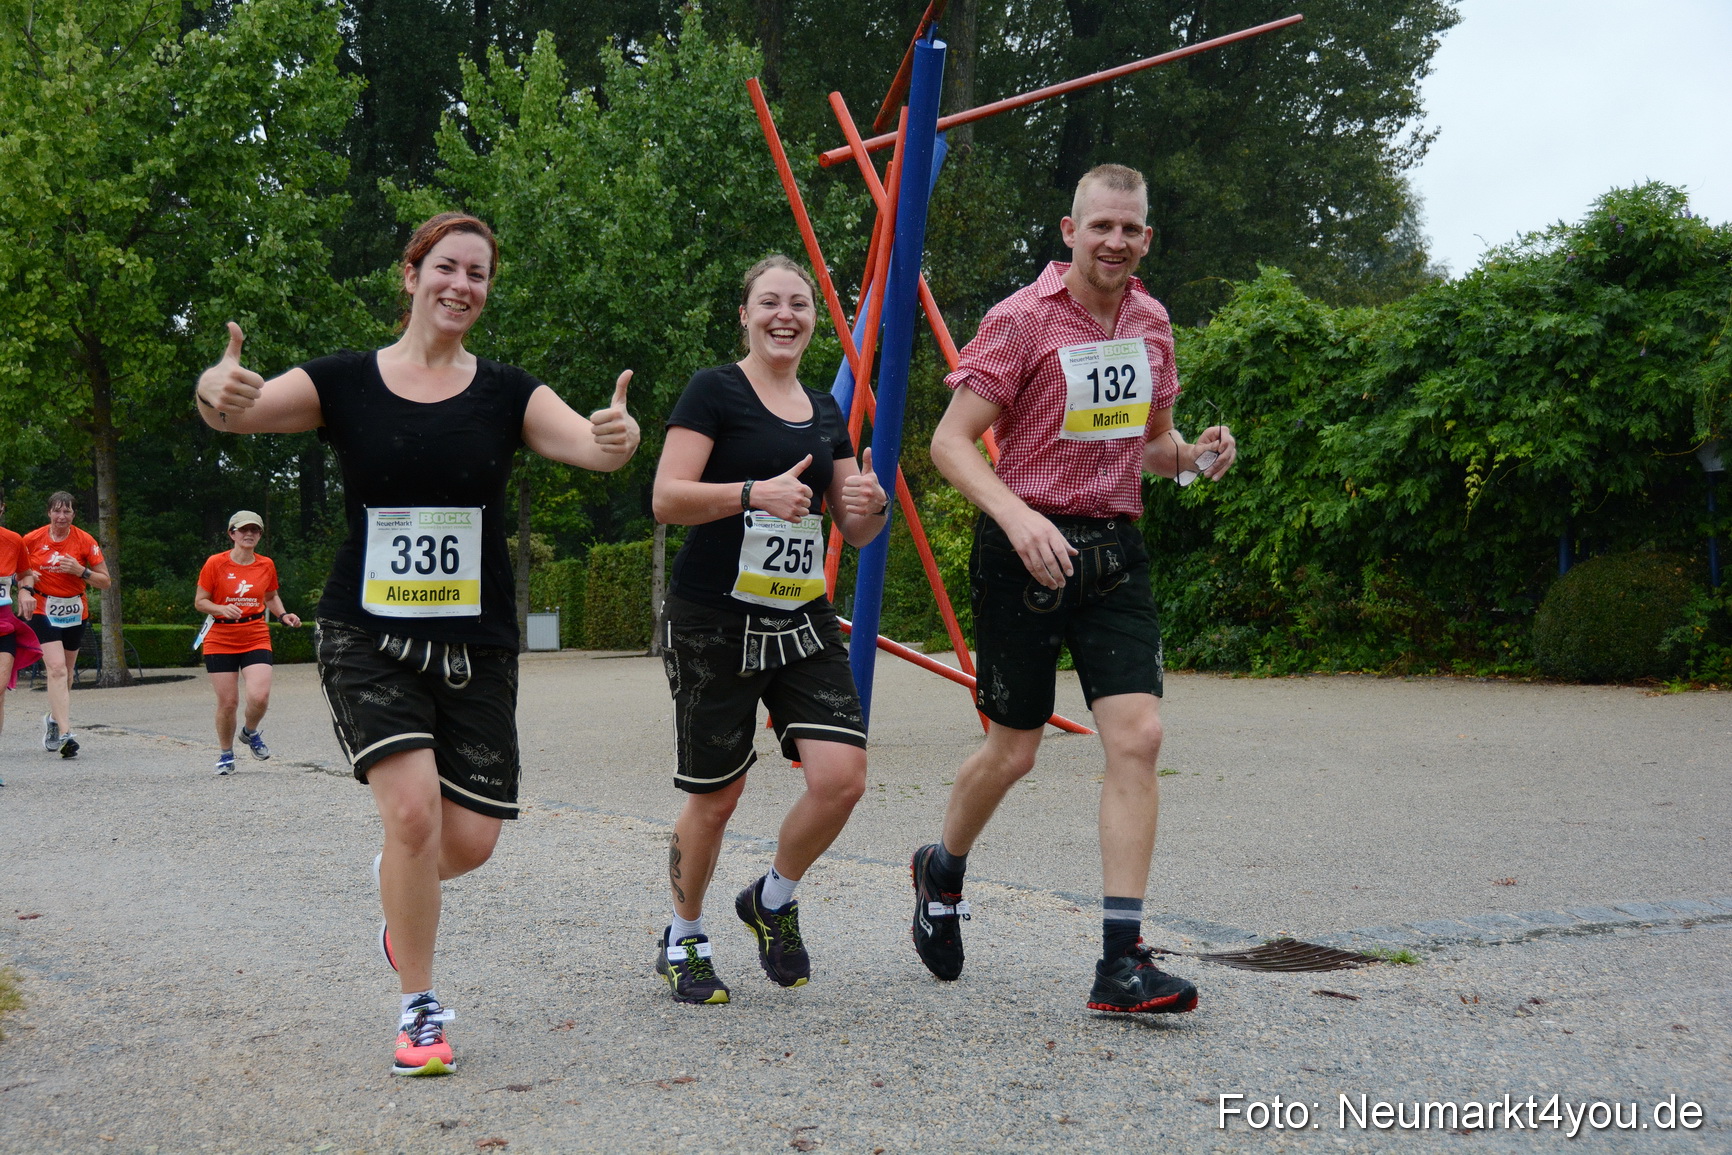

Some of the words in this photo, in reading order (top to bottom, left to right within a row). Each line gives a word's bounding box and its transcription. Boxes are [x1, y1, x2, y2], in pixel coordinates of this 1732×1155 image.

[1103, 343, 1139, 357] BOCK
[1069, 355, 1100, 363] NeuerMarkt
[1087, 364, 1137, 404] 132
[1093, 411, 1130, 427] Martin
[419, 512, 472, 525] BOCK
[391, 534, 460, 575] 336
[762, 536, 815, 574] 255
[386, 586, 460, 601] Alexandra
[769, 582, 801, 597] Karin
